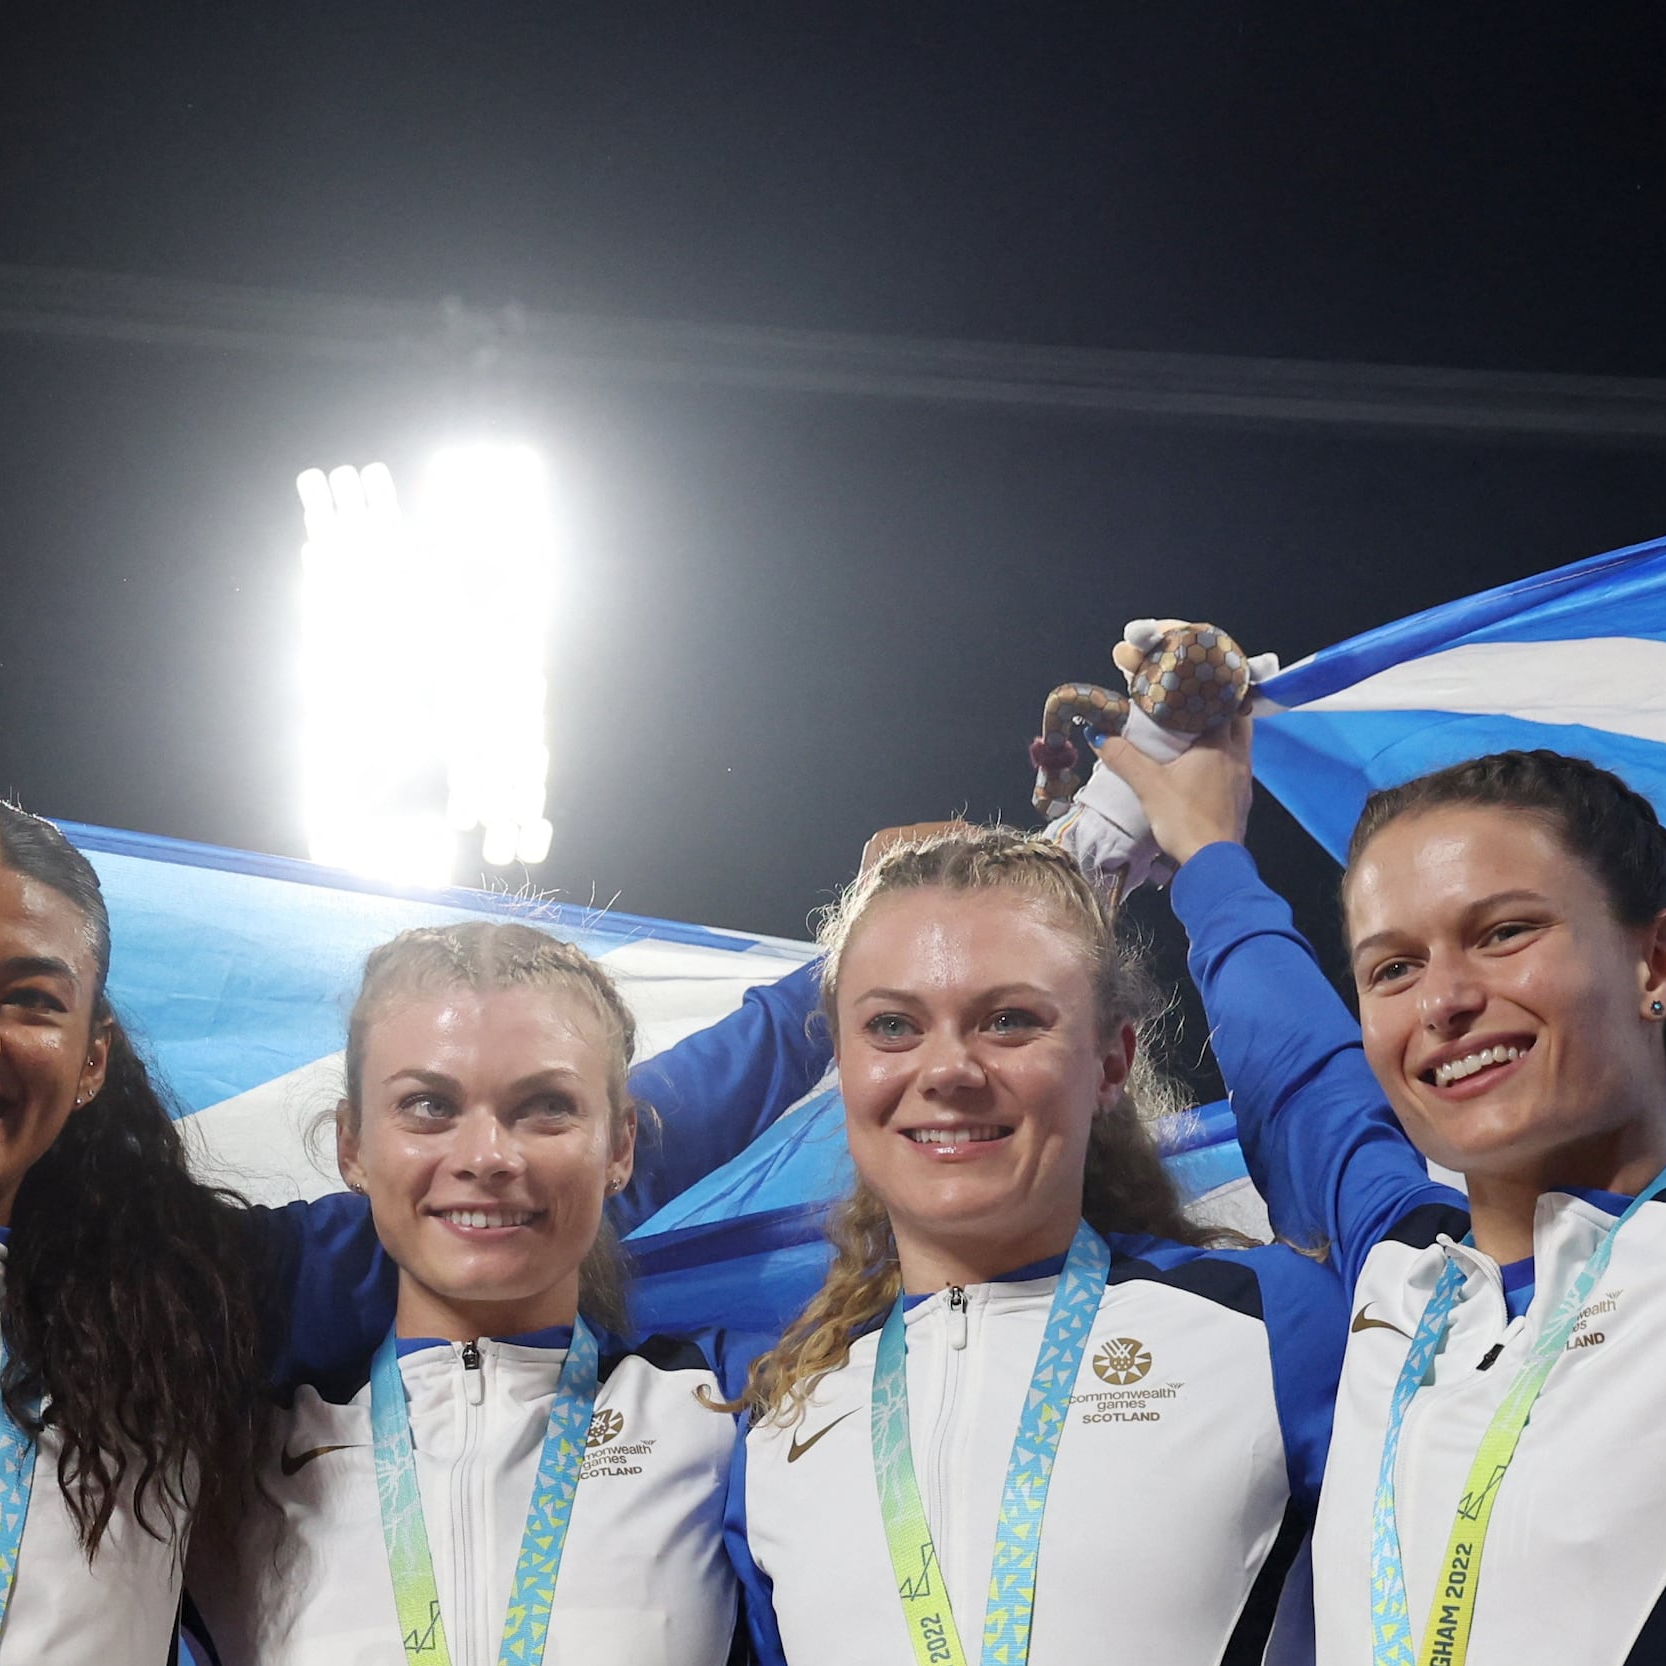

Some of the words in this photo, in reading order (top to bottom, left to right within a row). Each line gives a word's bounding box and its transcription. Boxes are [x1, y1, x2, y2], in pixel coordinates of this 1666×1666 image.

[1069, 1388, 1176, 1404] commonwealth
[1097, 1399, 1146, 1412] games
[1082, 1412, 1161, 1424] SCOTLAND
[583, 1455, 627, 1471] games
[1446, 1543, 1473, 1599] 2022
[920, 1613, 951, 1664] 2022
